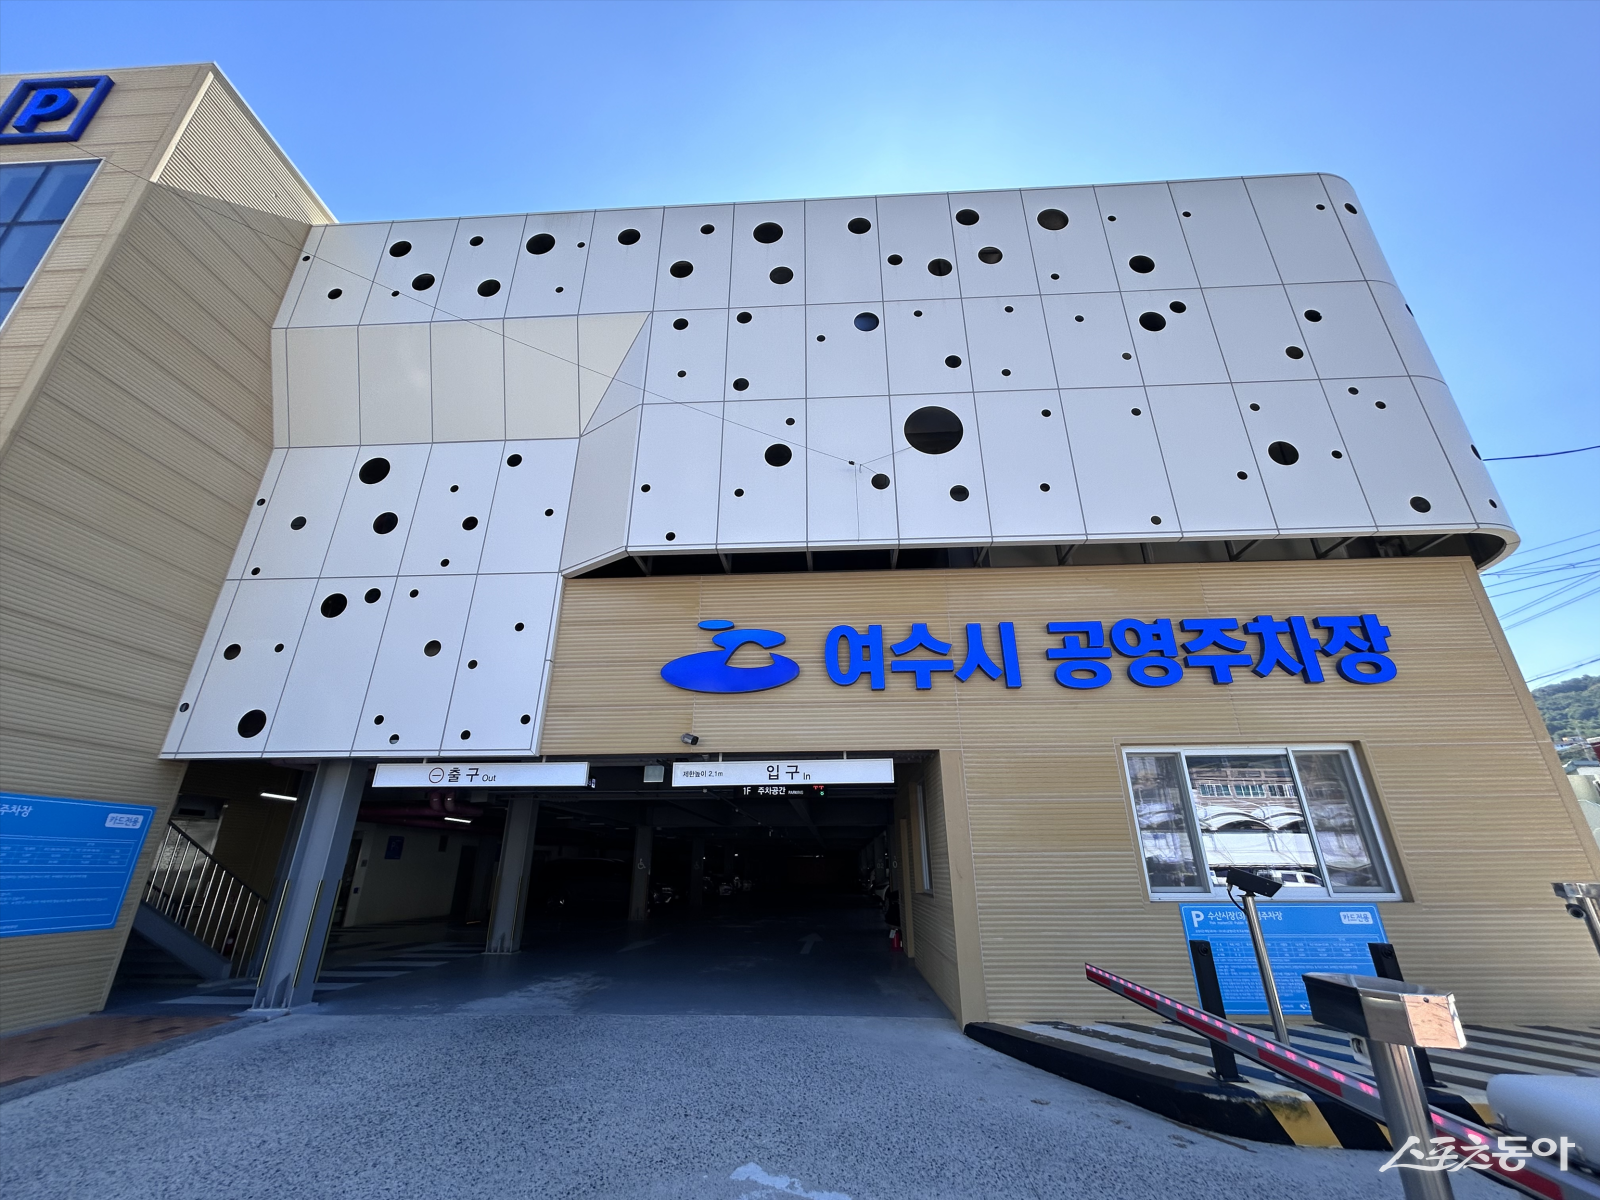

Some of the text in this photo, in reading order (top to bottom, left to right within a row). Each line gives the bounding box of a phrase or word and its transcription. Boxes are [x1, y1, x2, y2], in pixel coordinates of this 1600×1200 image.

[11, 87, 79, 133] P
[824, 613, 1398, 691] 여수시 공영주차장
[481, 774, 496, 782] Out
[683, 770, 724, 778] 제한높이 2.1m
[766, 764, 811, 781] 입구 In
[743, 786, 752, 795] 1F
[757, 786, 787, 796] 주차공간
[109, 815, 140, 827] 카드전용
[1191, 910, 1205, 928] P
[1342, 912, 1370, 923] 카드전용
